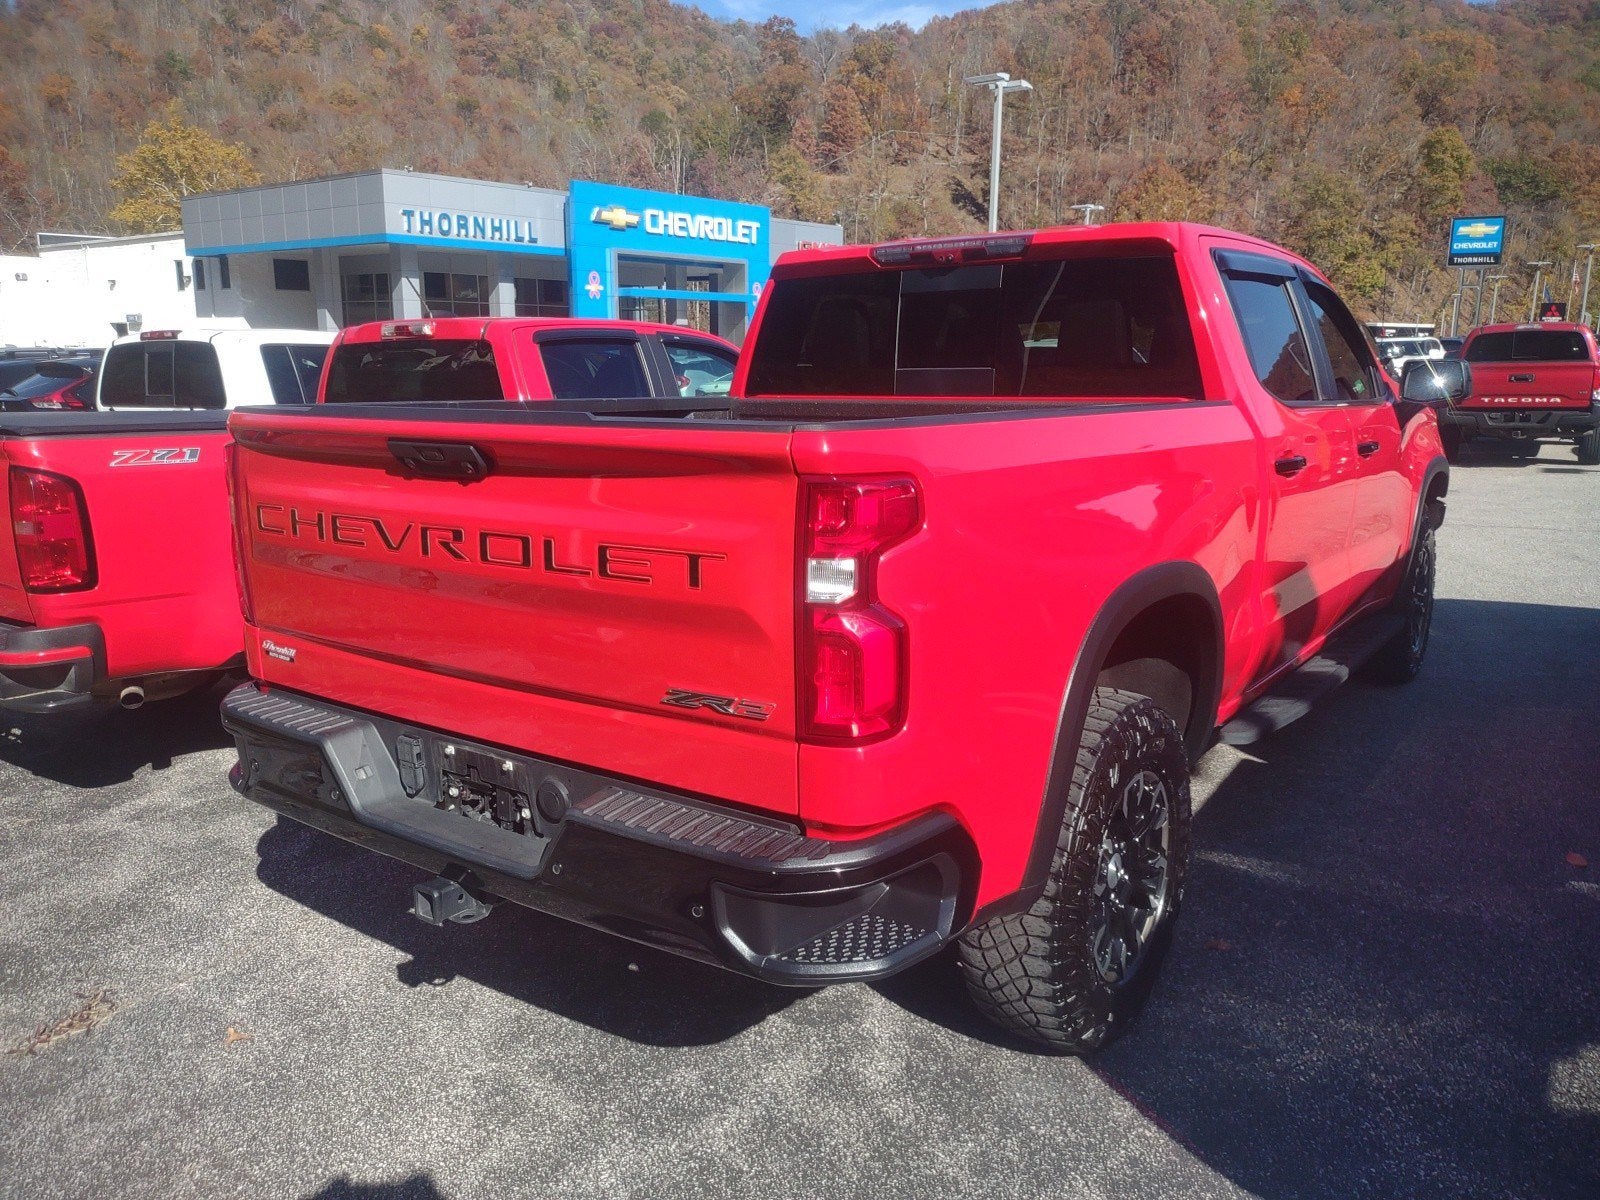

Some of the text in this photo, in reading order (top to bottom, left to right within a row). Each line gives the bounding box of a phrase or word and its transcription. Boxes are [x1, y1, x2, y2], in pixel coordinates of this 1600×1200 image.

[401, 208, 538, 244] THORNHILL
[644, 208, 760, 245] CHEVROLET
[1453, 241, 1498, 249] CHEVROLET
[256, 503, 728, 590] CHEVROLET
[660, 689, 777, 721] ZR2
